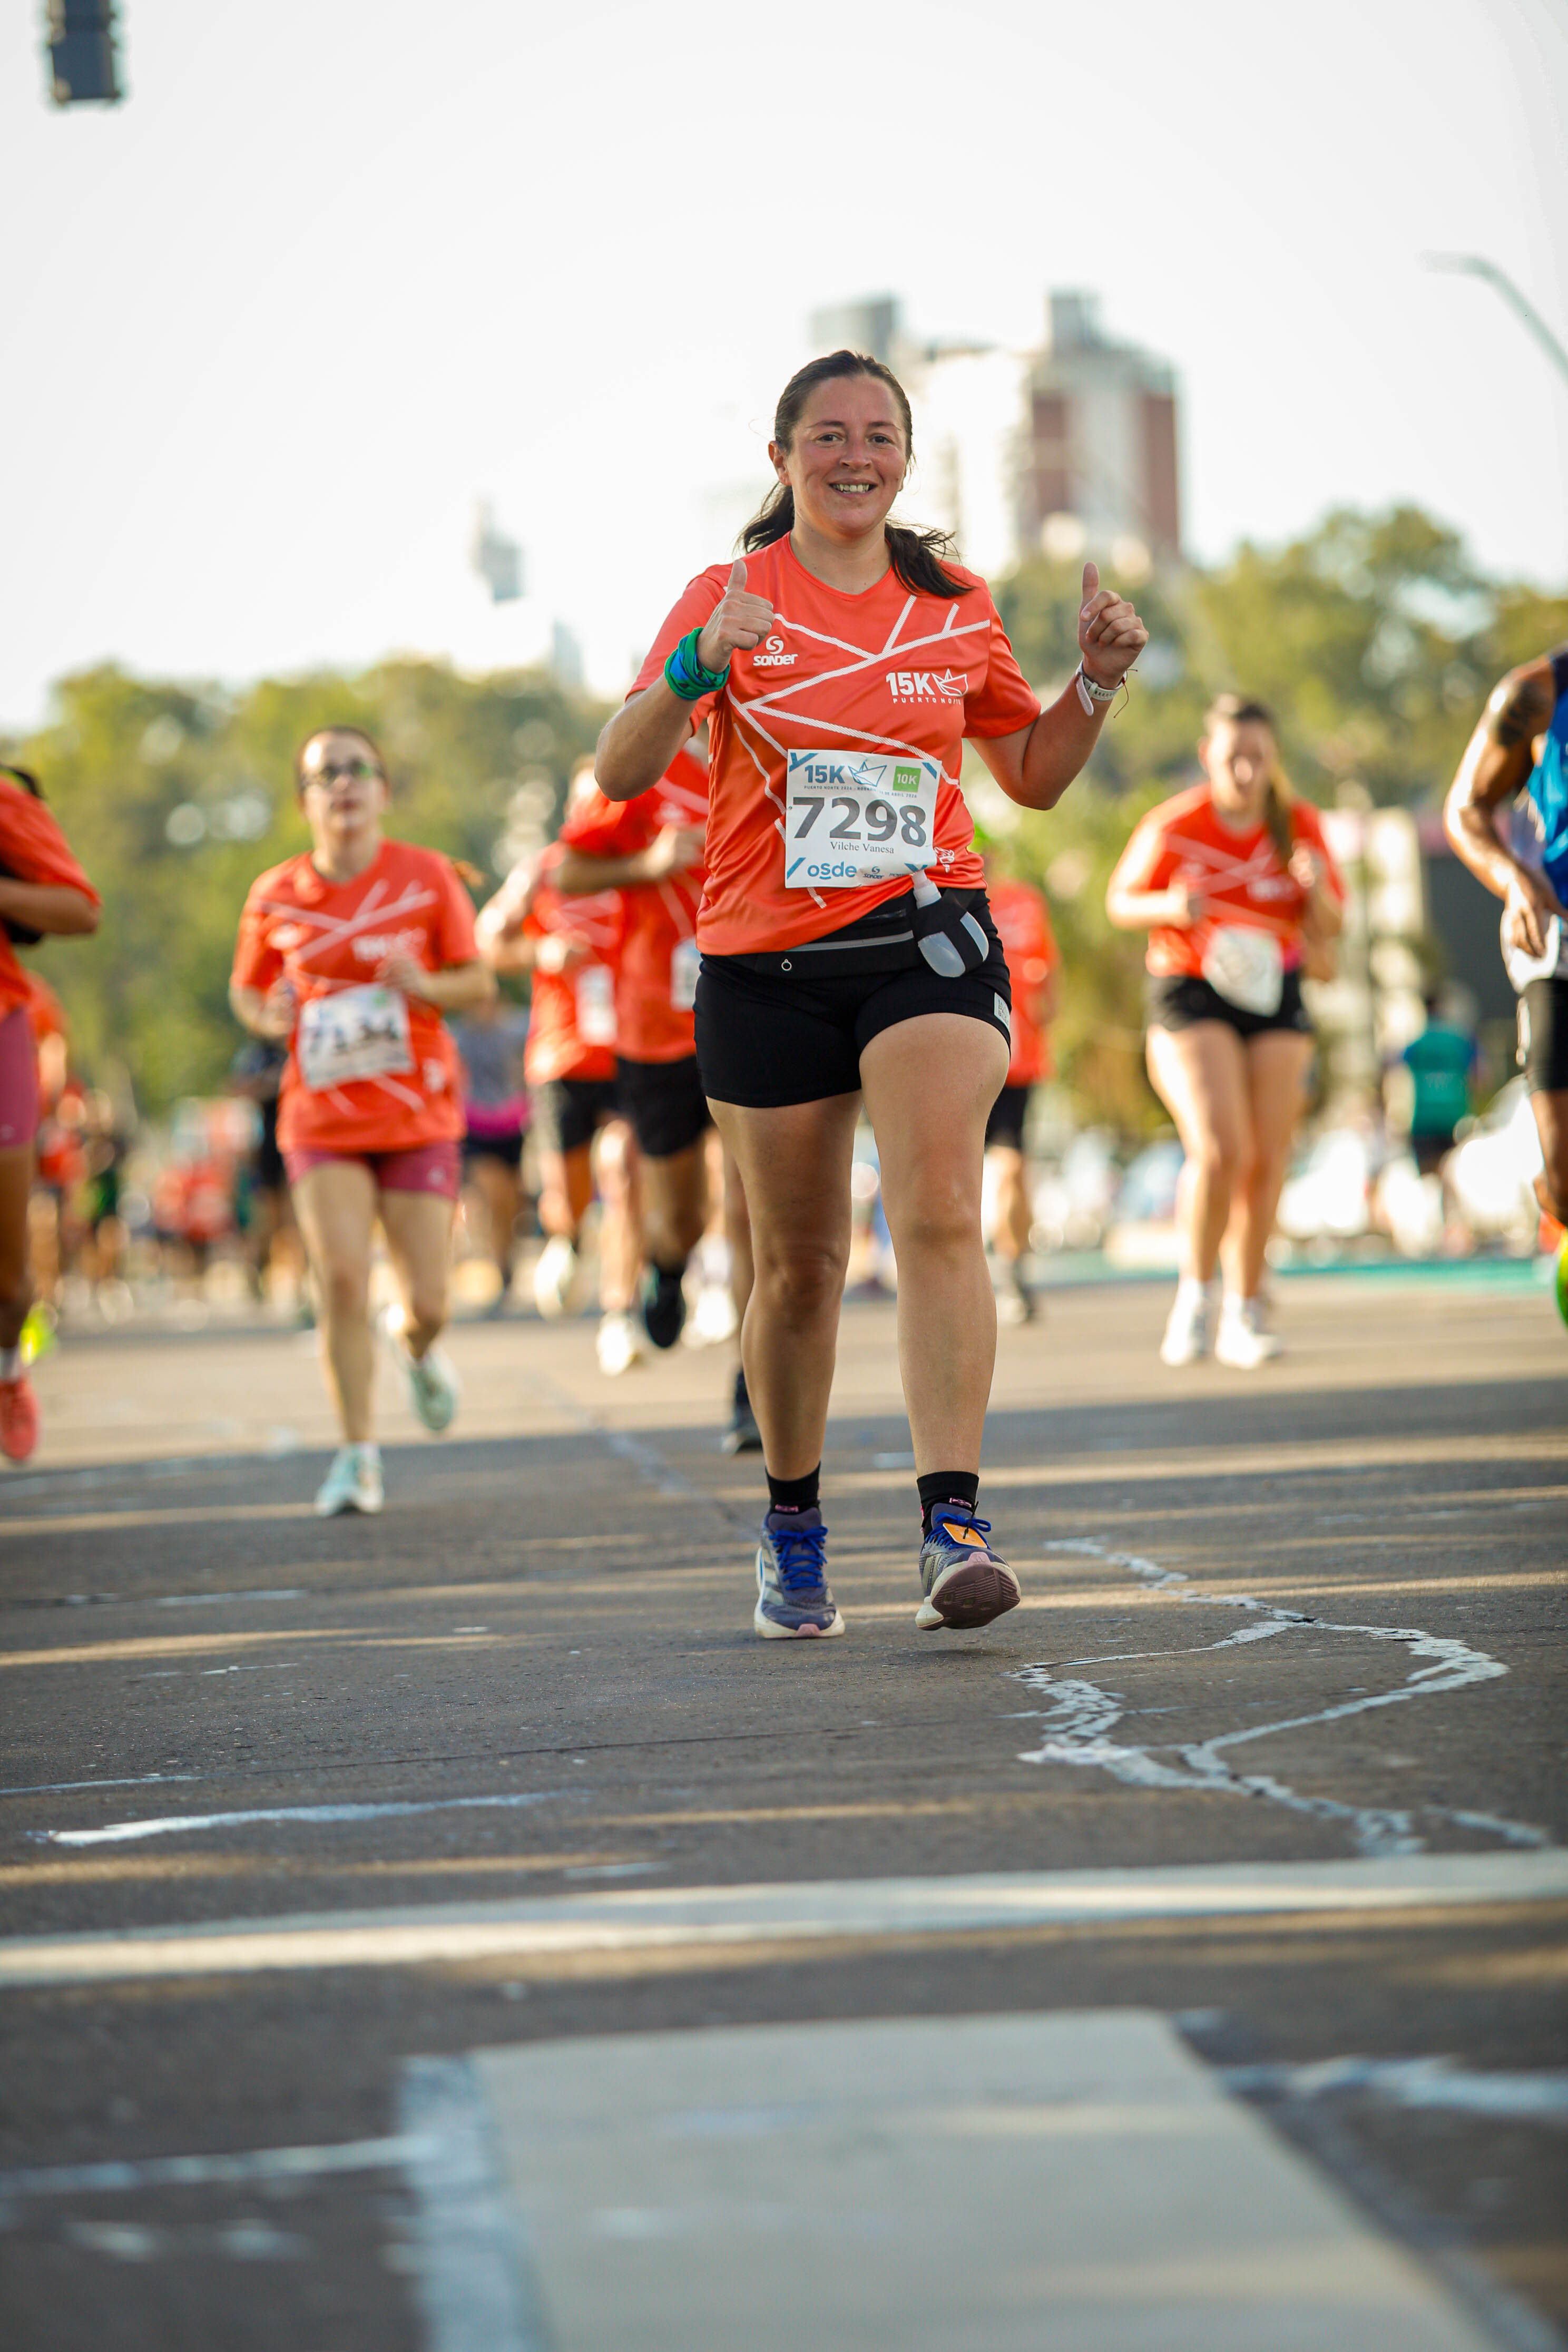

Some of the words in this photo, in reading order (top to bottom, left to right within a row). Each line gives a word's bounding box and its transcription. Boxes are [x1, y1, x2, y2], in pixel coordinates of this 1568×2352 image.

[886, 672, 935, 695] 15K
[804, 765, 845, 783] 15K
[897, 773, 916, 785] 10K
[792, 797, 926, 847] 7298
[830, 841, 860, 851] Vilche
[863, 843, 895, 854] Vanesa
